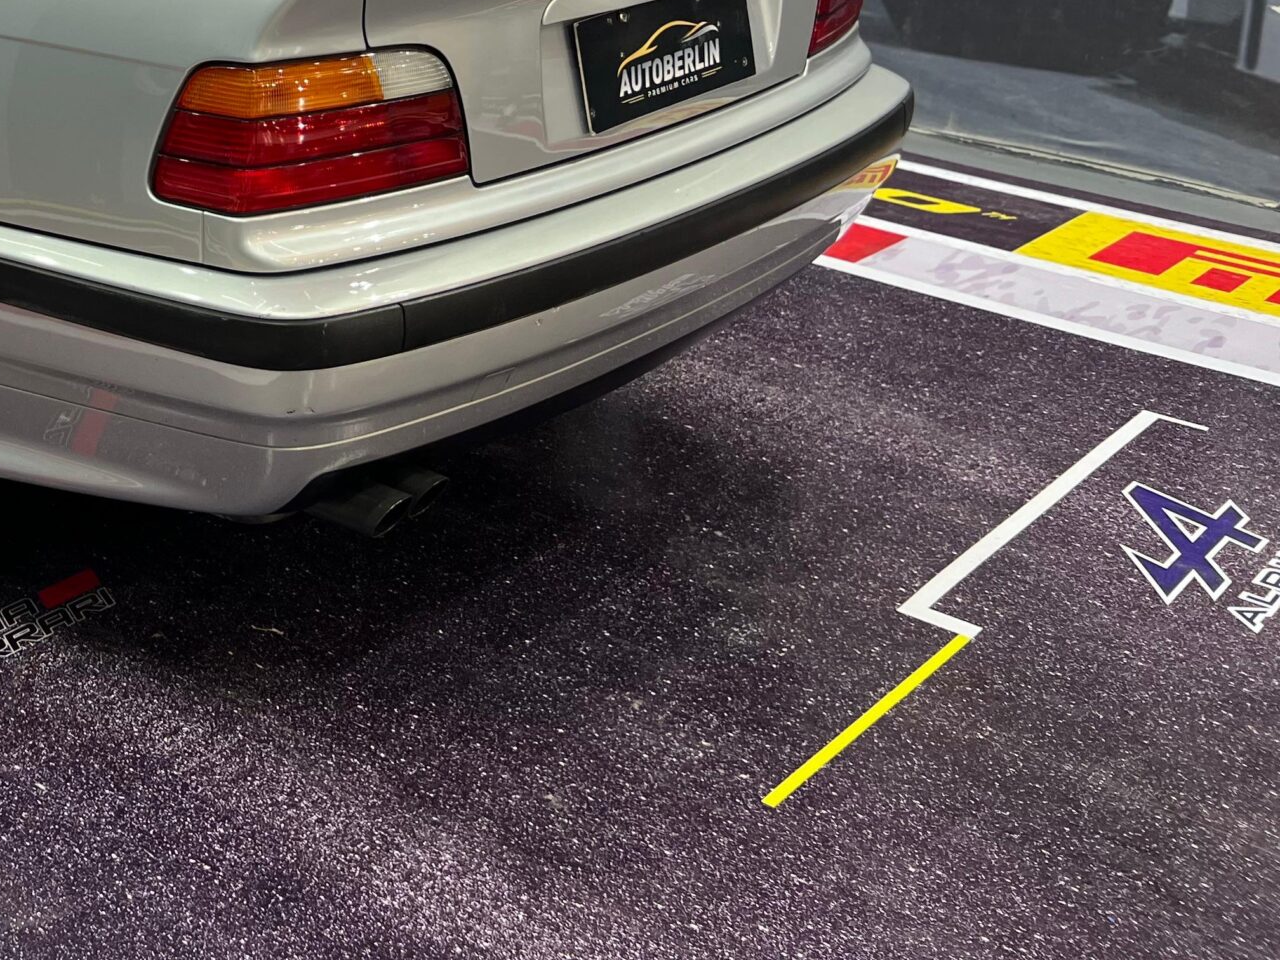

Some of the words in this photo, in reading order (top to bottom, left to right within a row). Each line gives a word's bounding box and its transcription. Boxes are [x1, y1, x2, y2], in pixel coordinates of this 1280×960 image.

[619, 38, 721, 98] AUTOBERLIN
[647, 81, 680, 98] PREMIUM
[681, 74, 699, 86] CARS
